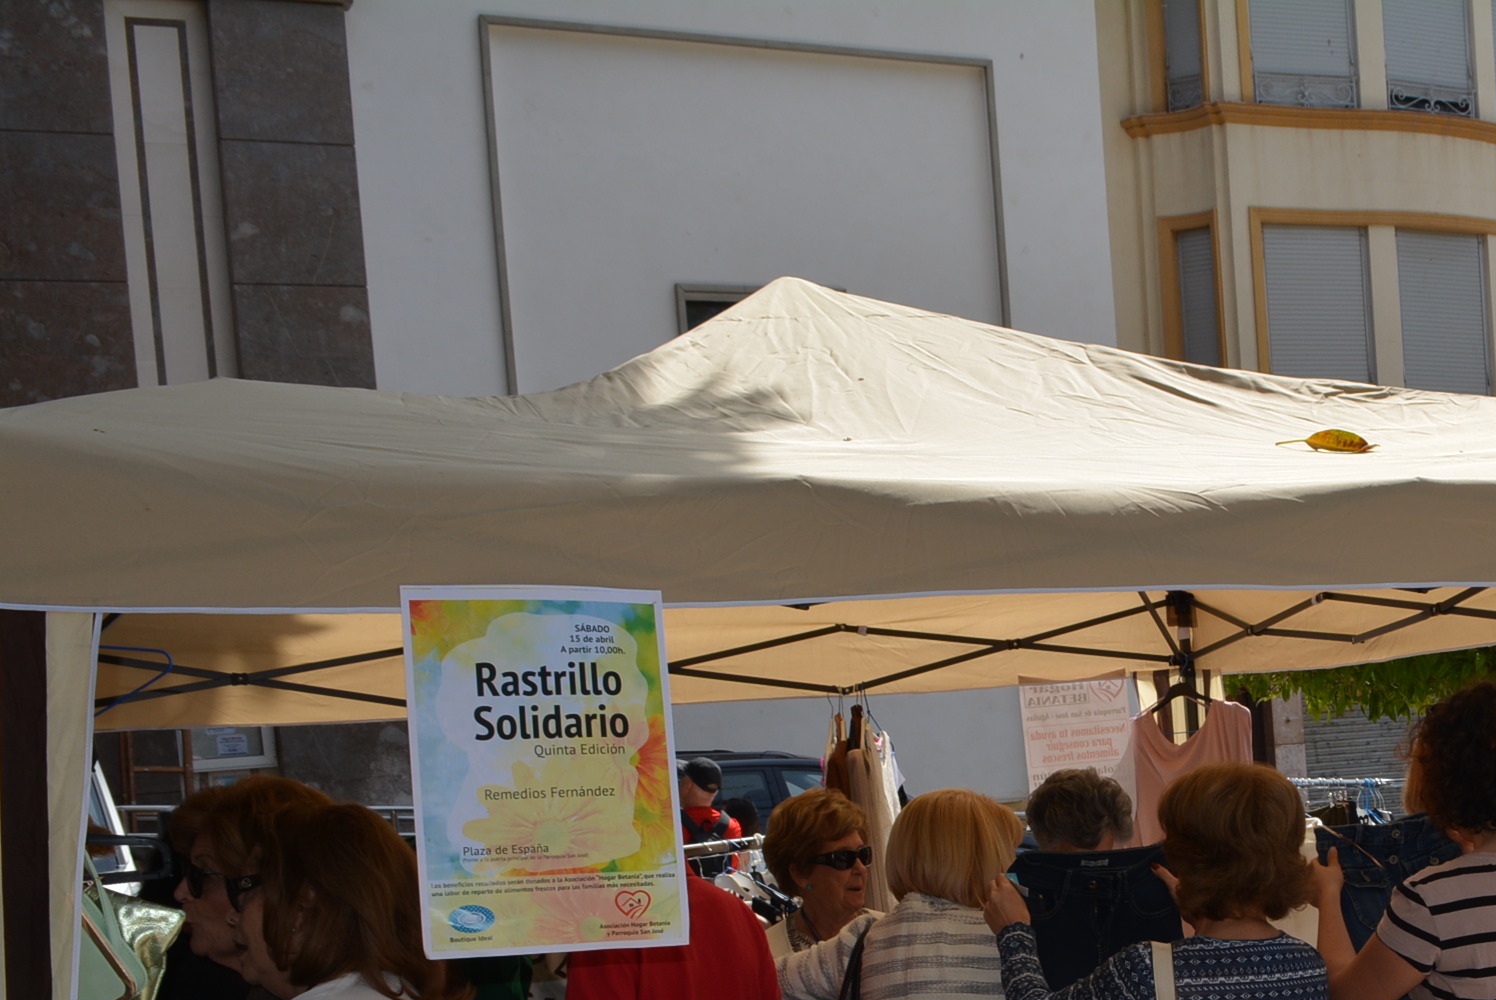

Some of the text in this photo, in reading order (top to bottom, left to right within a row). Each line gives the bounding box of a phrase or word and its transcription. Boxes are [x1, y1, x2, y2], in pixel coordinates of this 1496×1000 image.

[574, 623, 610, 633] SÁBADO
[583, 635, 593, 643] de
[569, 646, 592, 654] partir
[474, 661, 622, 697] Rastrillo
[473, 703, 629, 741] Solidario
[534, 743, 626, 758] Quinta Edición
[484, 786, 616, 800] Remedios Fernández
[463, 844, 549, 856] Plaza de España
